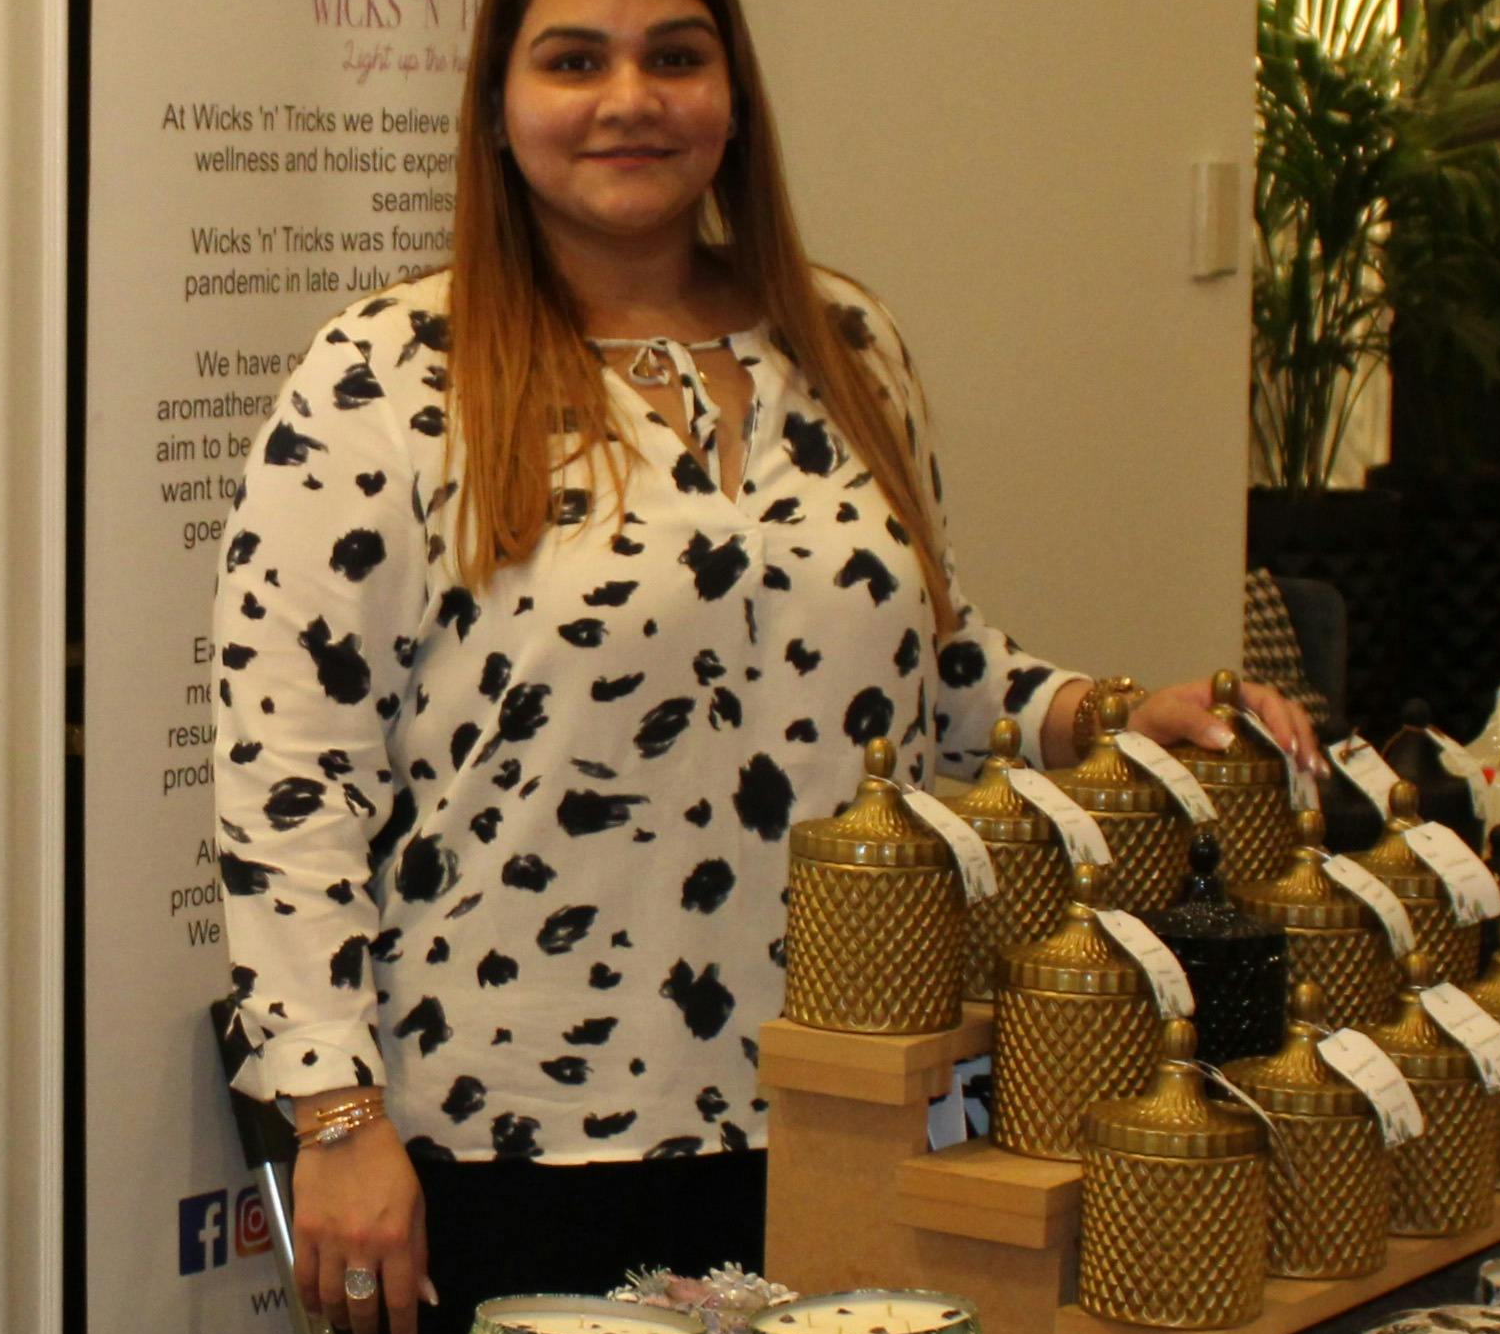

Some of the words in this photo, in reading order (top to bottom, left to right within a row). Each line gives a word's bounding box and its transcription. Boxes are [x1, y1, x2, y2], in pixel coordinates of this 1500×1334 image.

[161, 103, 186, 131] At
[192, 103, 254, 132] Wicks
[284, 105, 337, 133] Tricks
[343, 112, 374, 133] we
[381, 107, 450, 134] believe
[194, 146, 280, 174] wellness
[285, 147, 318, 174] and
[323, 147, 397, 174] holistic
[191, 225, 251, 255] Wicks
[282, 226, 334, 253] Tricks
[341, 229, 384, 252] was
[184, 267, 281, 302] pandemic
[286, 268, 301, 293] in
[306, 266, 340, 294] late
[196, 349, 230, 378] We
[236, 348, 282, 377] have
[156, 389, 279, 421] aromathera
[156, 433, 196, 463] aim
[202, 433, 221, 460] to
[160, 474, 213, 504] want
[218, 473, 238, 500] to
[183, 520, 228, 550] goe
[187, 920, 222, 948] We
